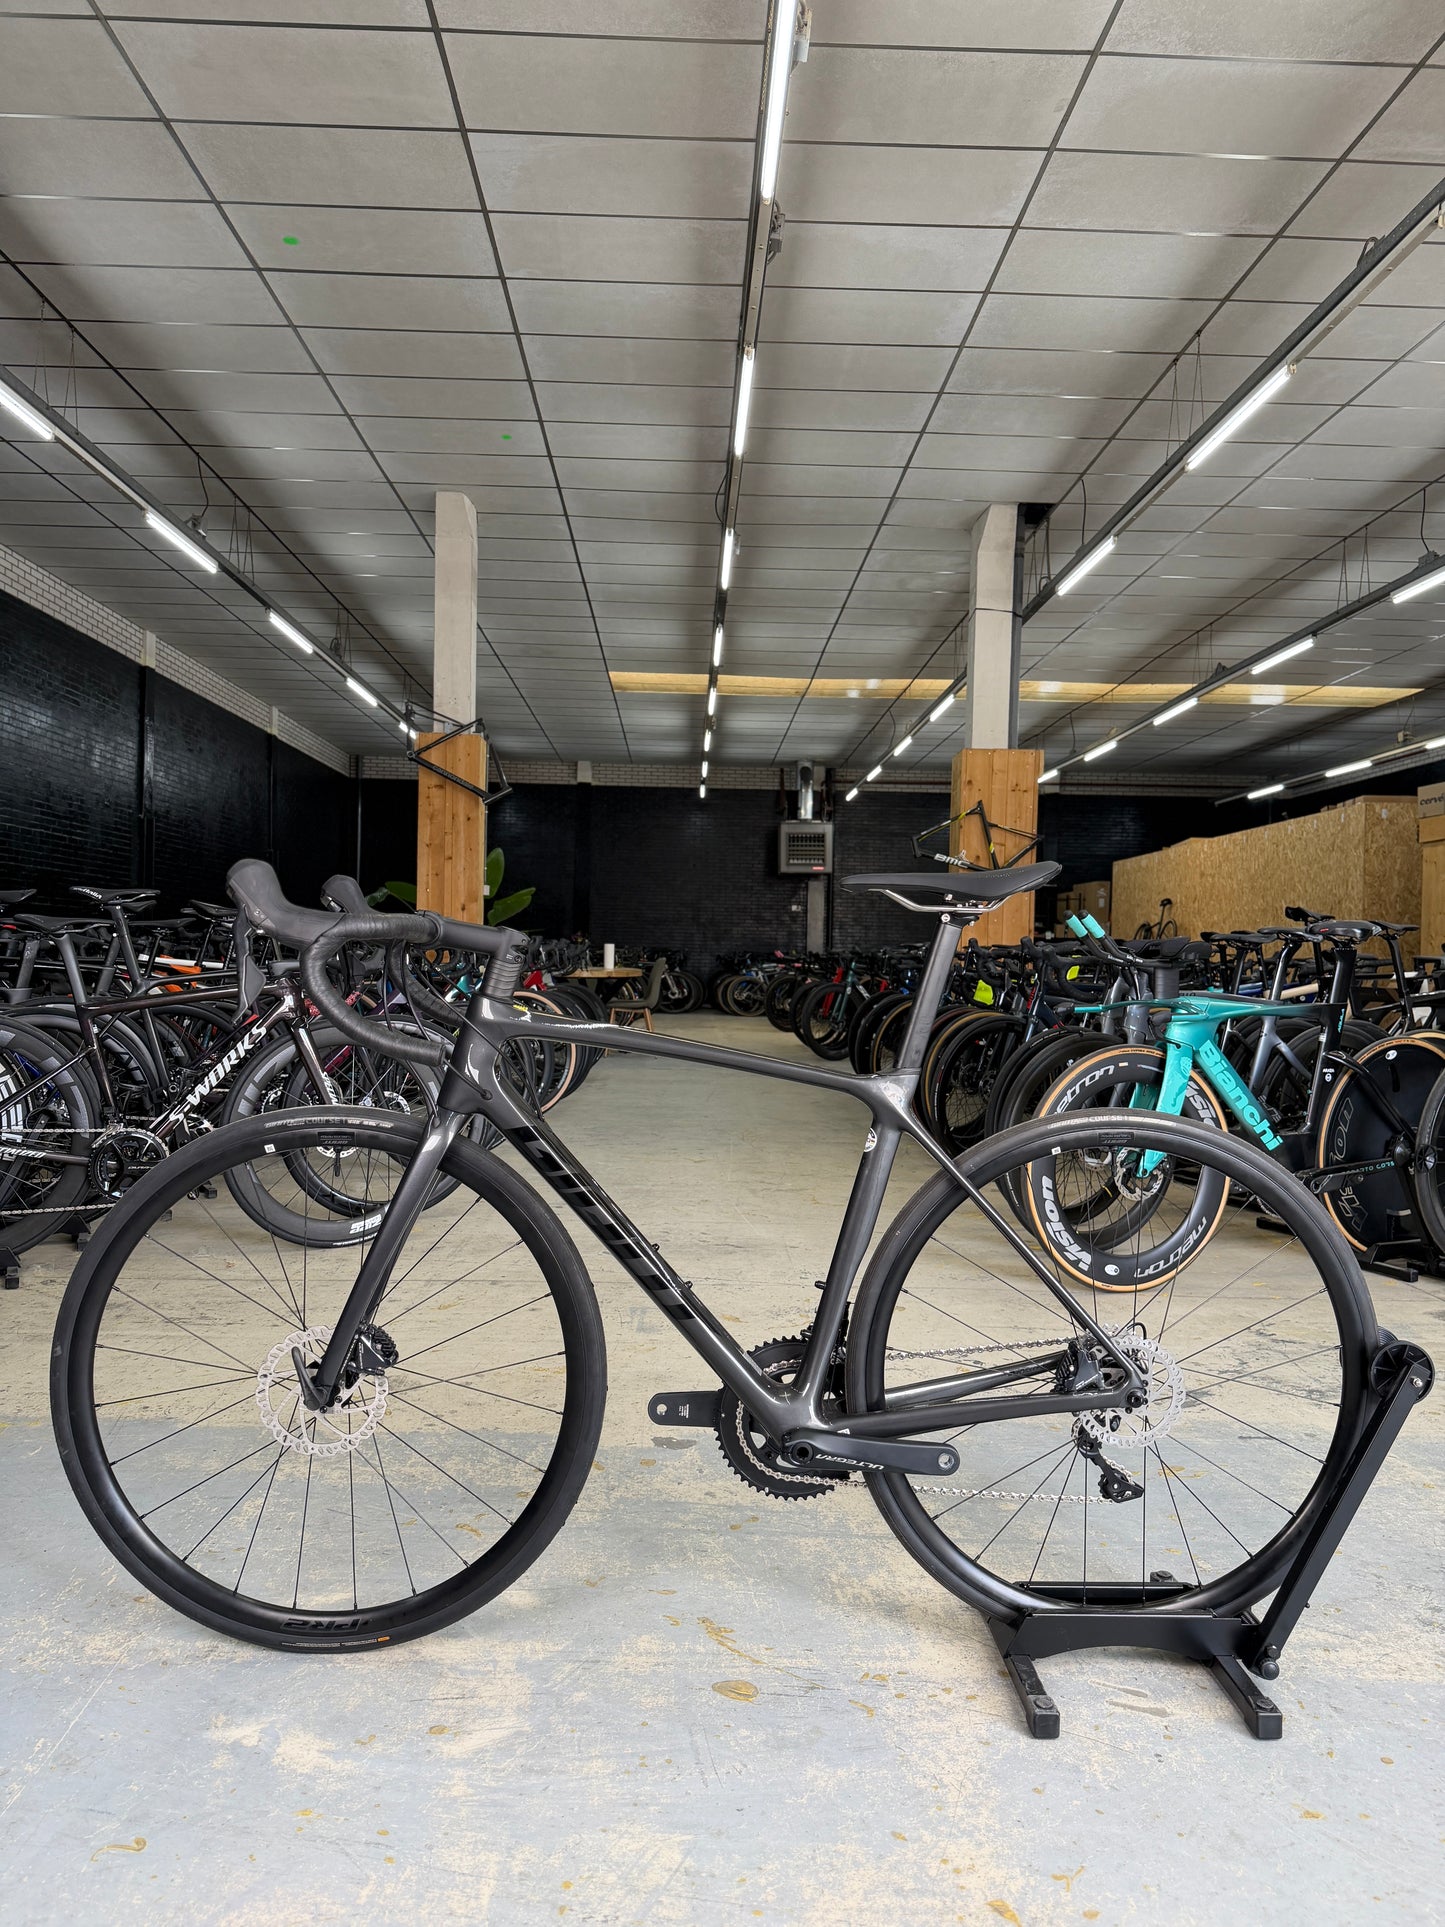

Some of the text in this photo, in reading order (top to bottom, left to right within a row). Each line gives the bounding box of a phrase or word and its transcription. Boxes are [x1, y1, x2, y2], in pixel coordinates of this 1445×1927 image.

[169, 1022, 267, 1129] S-WORKS
[1055, 1063, 1115, 1114] etron
[1199, 1039, 1283, 1151] Bianchi
[1133, 1216, 1207, 1279] metron
[815, 1453, 885, 1472] ULTEGRA
